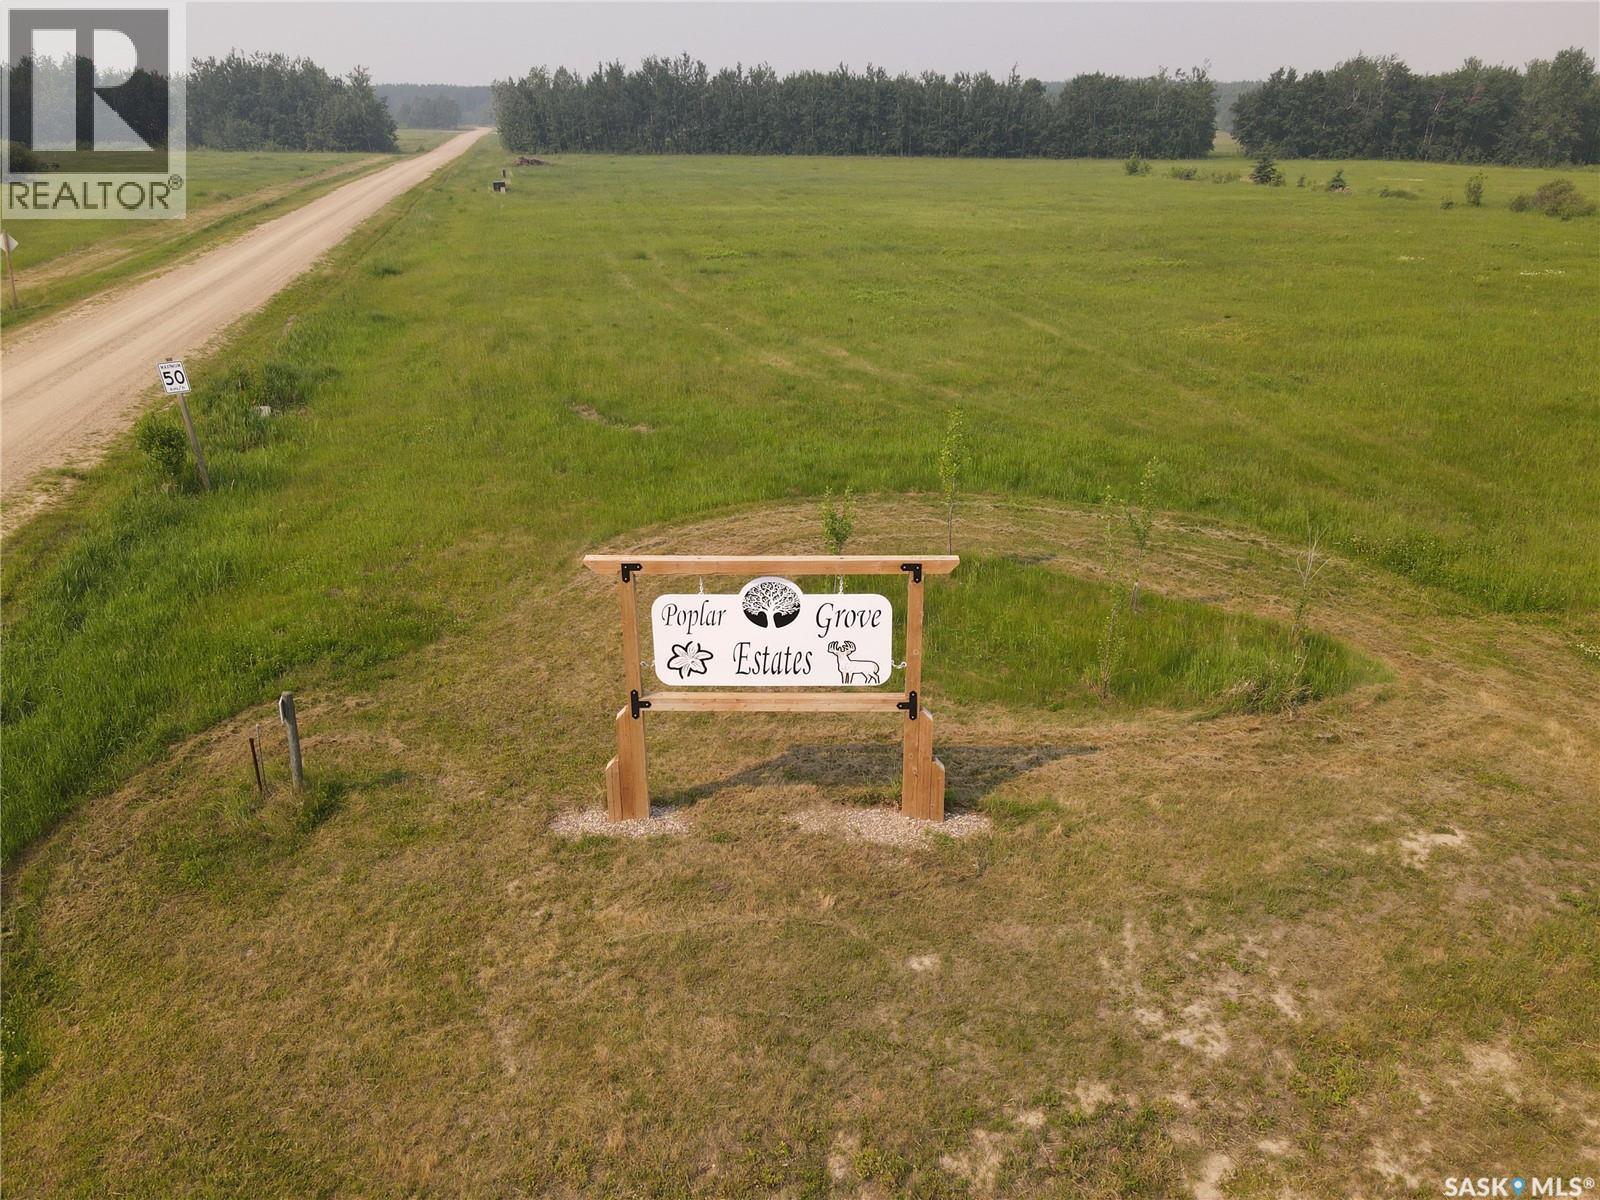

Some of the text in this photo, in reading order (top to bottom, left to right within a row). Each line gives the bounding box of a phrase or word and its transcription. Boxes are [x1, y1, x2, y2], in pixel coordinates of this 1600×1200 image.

[163, 370, 185, 386] 50
[661, 600, 882, 638] Poplar Grove
[733, 641, 813, 675] Estates
